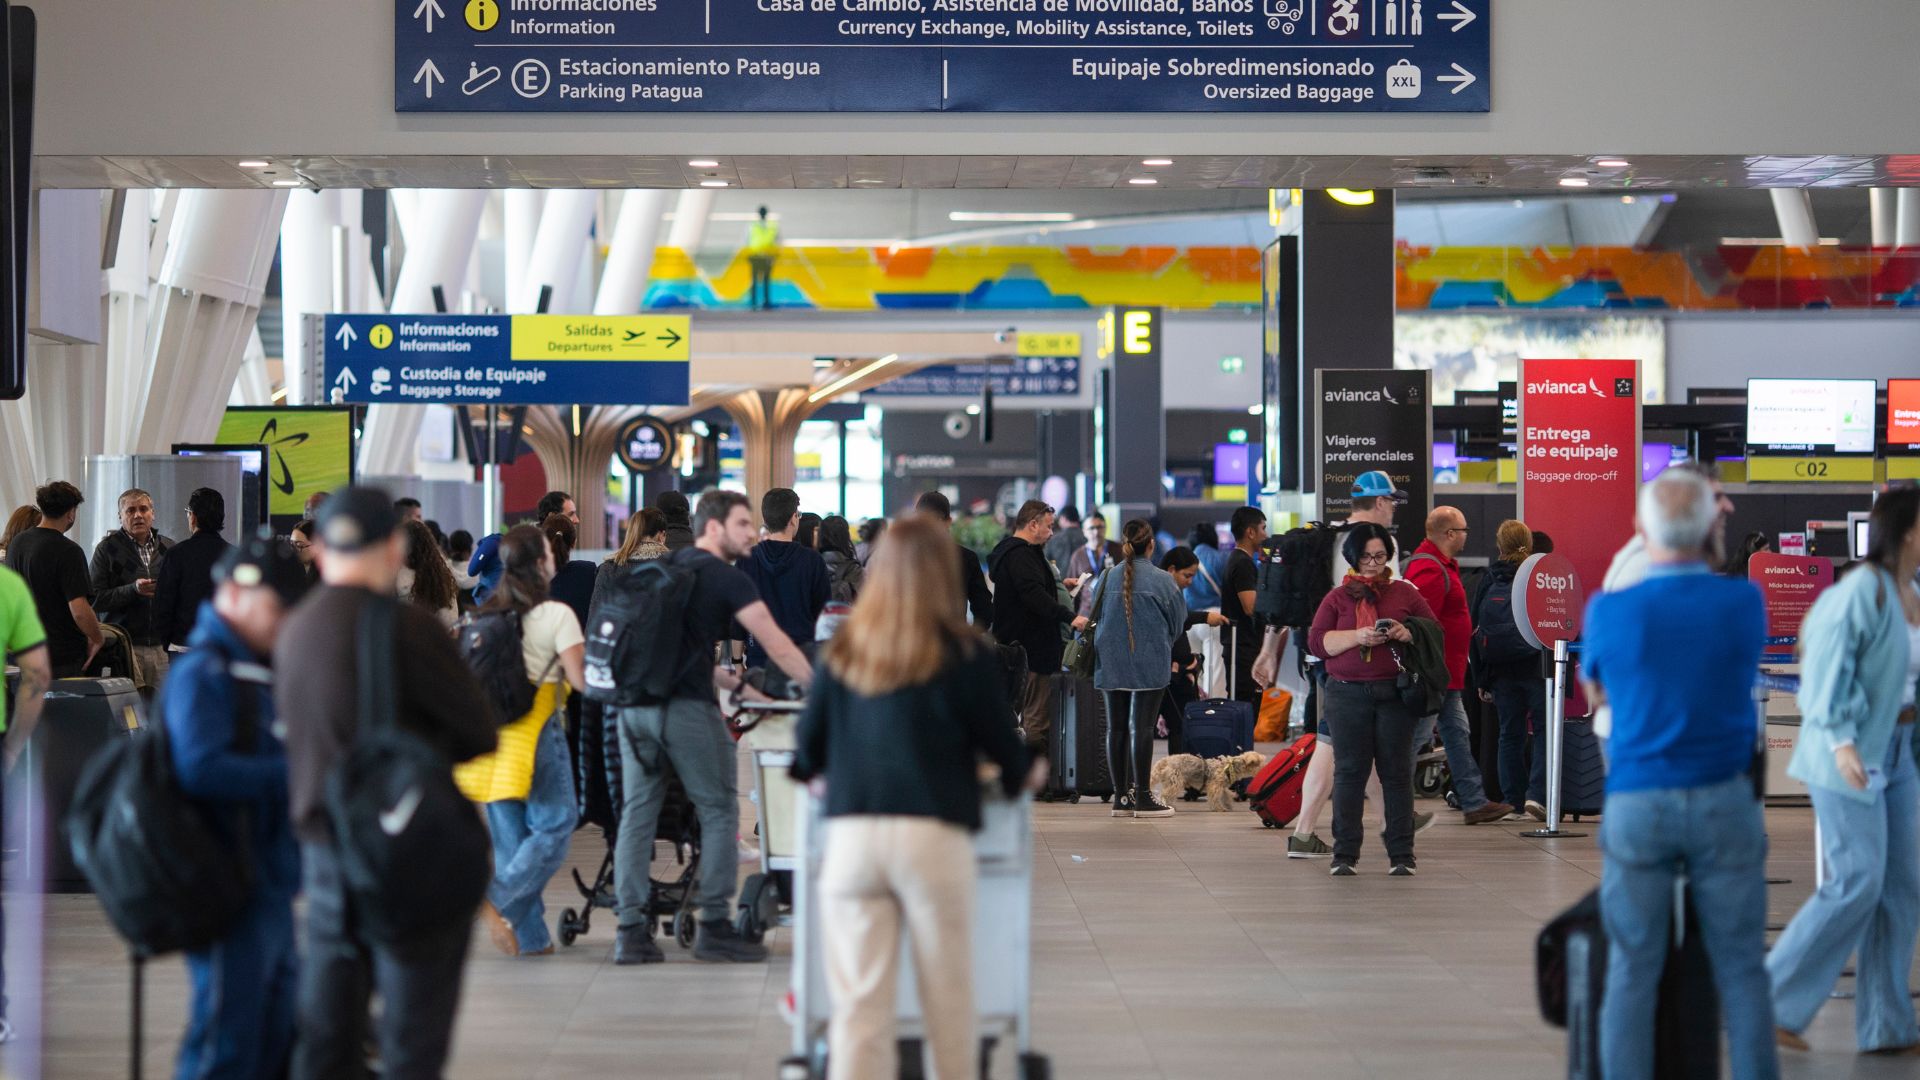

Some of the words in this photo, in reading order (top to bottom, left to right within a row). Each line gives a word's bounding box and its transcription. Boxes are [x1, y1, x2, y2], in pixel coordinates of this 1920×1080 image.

[511, 0, 657, 11] Informaciones
[757, 0, 804, 11] Casa
[811, 0, 836, 11] de
[843, 0, 926, 14] Cambio,
[933, 0, 1036, 12] Asistencia
[1044, 0, 1072, 12] de
[1076, 0, 1186, 15] Movilidad,
[511, 19, 616, 34] Information
[838, 20, 917, 38] Currency
[921, 20, 1010, 38] Exchange,
[1016, 20, 1090, 39] Mobility
[1095, 20, 1193, 38] Assistance,
[1197, 20, 1254, 35] Toilets
[560, 58, 730, 75] Estacionamiento
[737, 59, 820, 79] Patagua
[1072, 58, 1161, 80] Equipaje
[1168, 58, 1375, 76] Sobredimensionado
[523, 66, 538, 90] E
[1392, 76, 1416, 87] XXL
[560, 84, 625, 102] Parking
[632, 84, 703, 102] Patagua
[1204, 84, 1292, 99] Oversized
[1297, 84, 1374, 103] Baggage
[400, 322, 499, 336] Informaciones
[565, 324, 613, 336] Salidas
[1124, 311, 1152, 354] E
[400, 339, 471, 352] Information
[547, 341, 613, 354] Departures
[400, 366, 461, 380] Custodia
[464, 366, 483, 380] de
[486, 367, 547, 384] Equipaje
[400, 384, 452, 398] Baggage
[454, 384, 502, 399] Storage
[1527, 379, 1587, 394] avianca
[1325, 388, 1381, 402] avianca
[1325, 435, 1376, 448] Viajeros
[1526, 426, 1591, 443] Entrega
[1325, 450, 1414, 464] preferenciales
[1526, 444, 1546, 457] de
[1549, 444, 1618, 461] equipaje
[1526, 470, 1571, 482] Baggage
[1573, 470, 1618, 482] drop-off
[1764, 566, 1796, 574] avianca
[1536, 572, 1567, 594] Step
[1568, 573, 1574, 590] 1
[1790, 583, 1815, 591] equipaje
[1537, 619, 1558, 628] avianca
